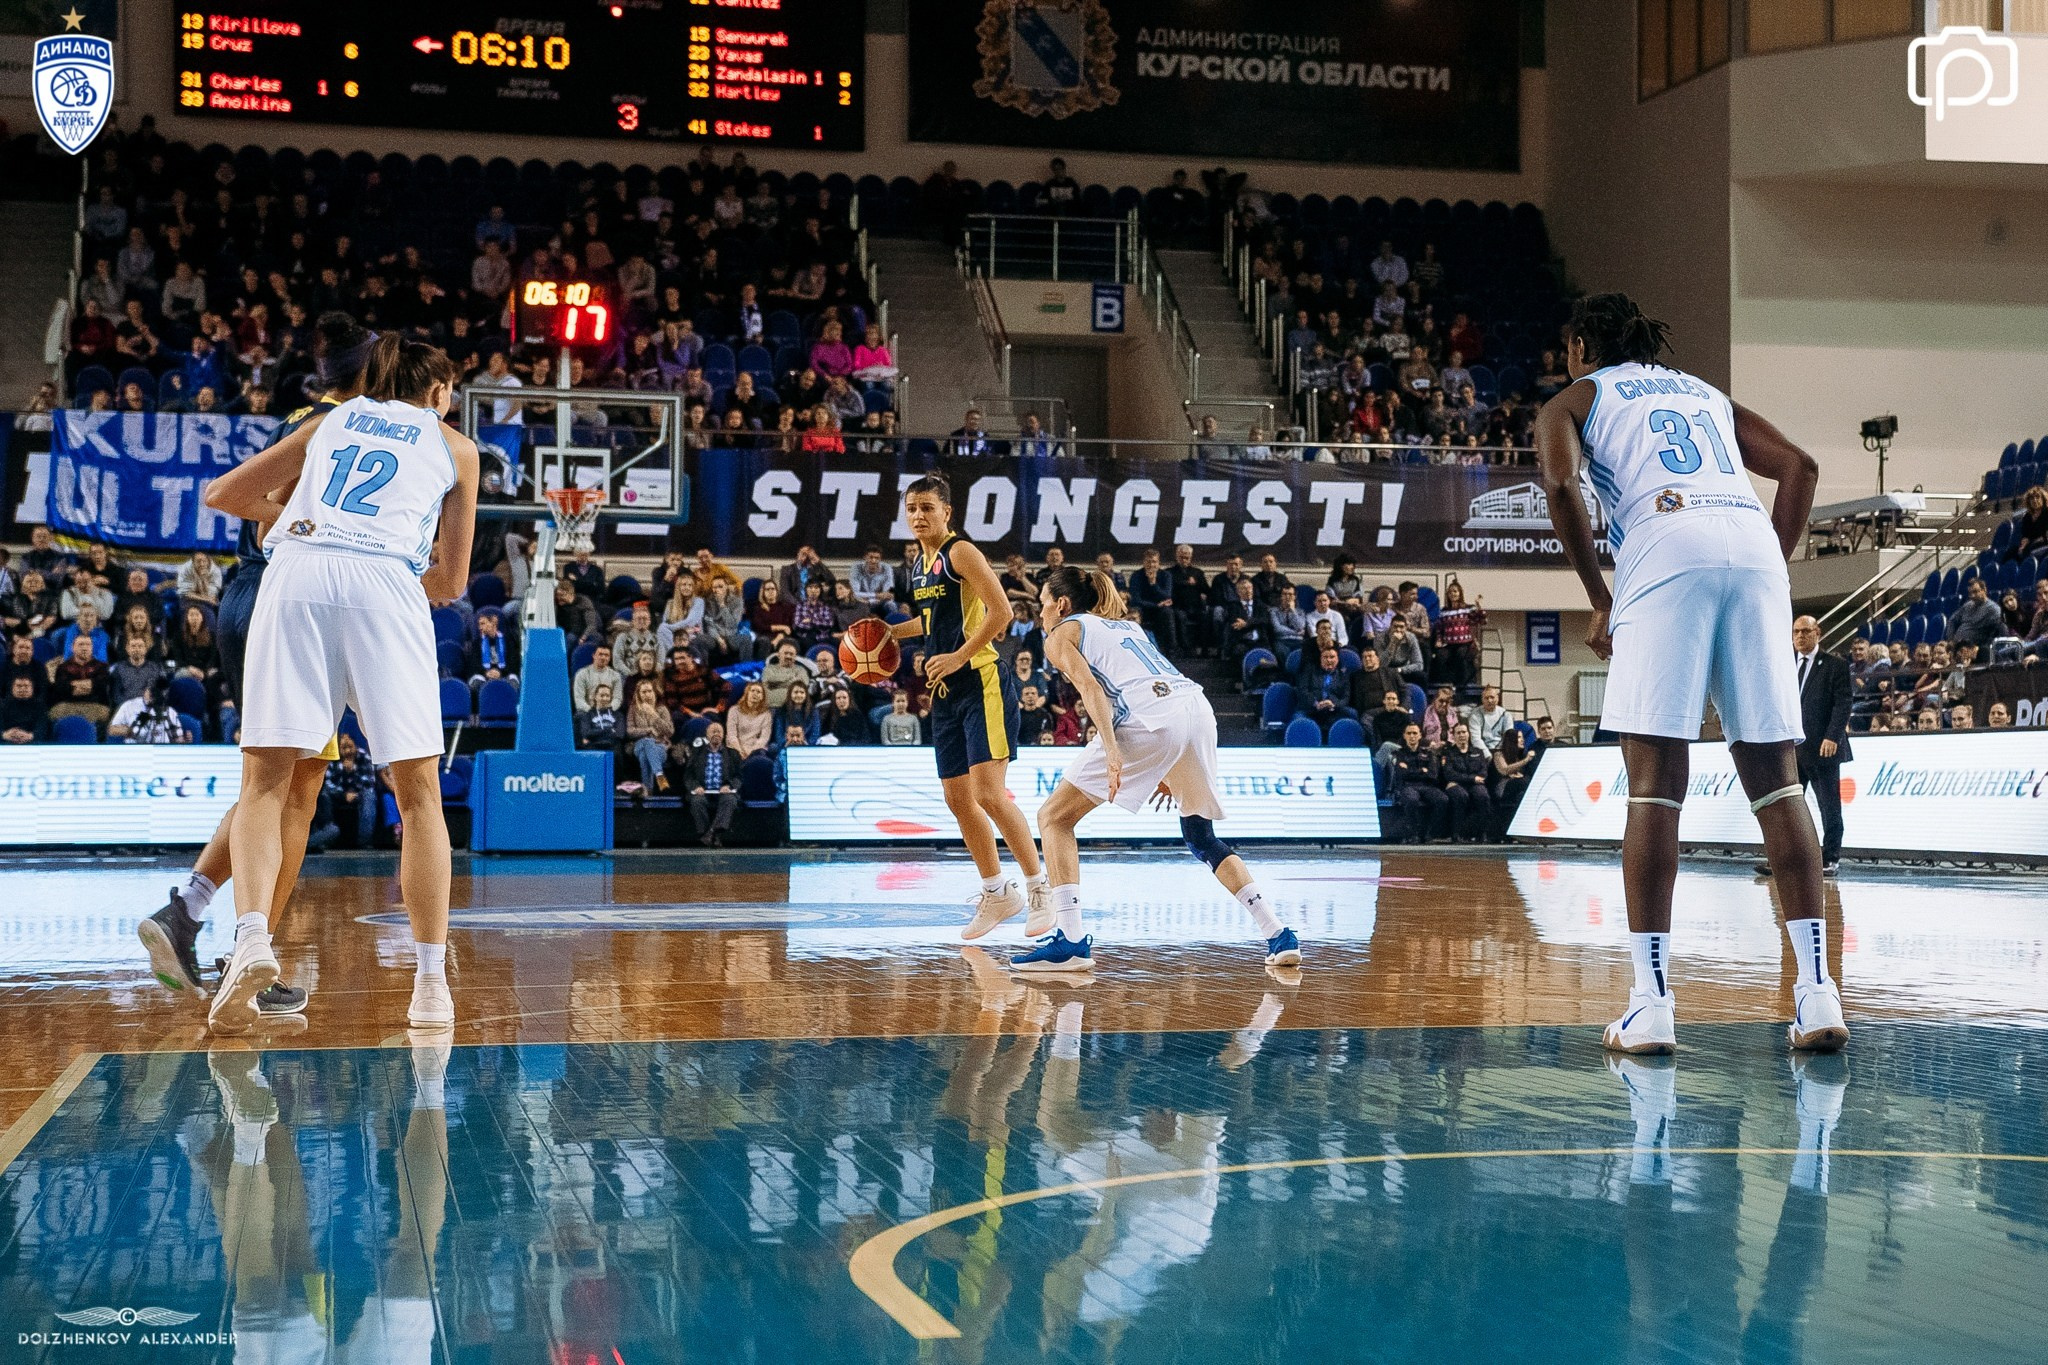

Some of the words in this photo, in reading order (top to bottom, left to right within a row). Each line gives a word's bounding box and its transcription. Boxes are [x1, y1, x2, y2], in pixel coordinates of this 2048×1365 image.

[182, 13, 204, 29] 13
[690, 26, 710, 42] 15
[182, 33, 204, 49] 15
[209, 34, 253, 52] Cruz
[344, 42, 359, 59] 6
[452, 31, 570, 70] 06:10
[1136, 27, 1340, 55] АДМИНИСТРАЦИЯ
[209, 72, 282, 93] Charles
[317, 79, 328, 96] 1
[344, 81, 359, 97] 6
[1137, 51, 1290, 83] КУРСКОЙ
[1299, 65, 1450, 91] ОБЛАСТИ
[617, 104, 639, 130] 3
[688, 119, 708, 135] 41
[714, 120, 772, 138] Stokes
[565, 305, 607, 340] 17
[1614, 378, 1710, 401] CHARLES
[344, 411, 421, 445] VIDMER
[1649, 409, 1735, 475] 31
[321, 444, 399, 517] 12
[923, 608, 931, 636] 7
[504, 772, 585, 793] molten
